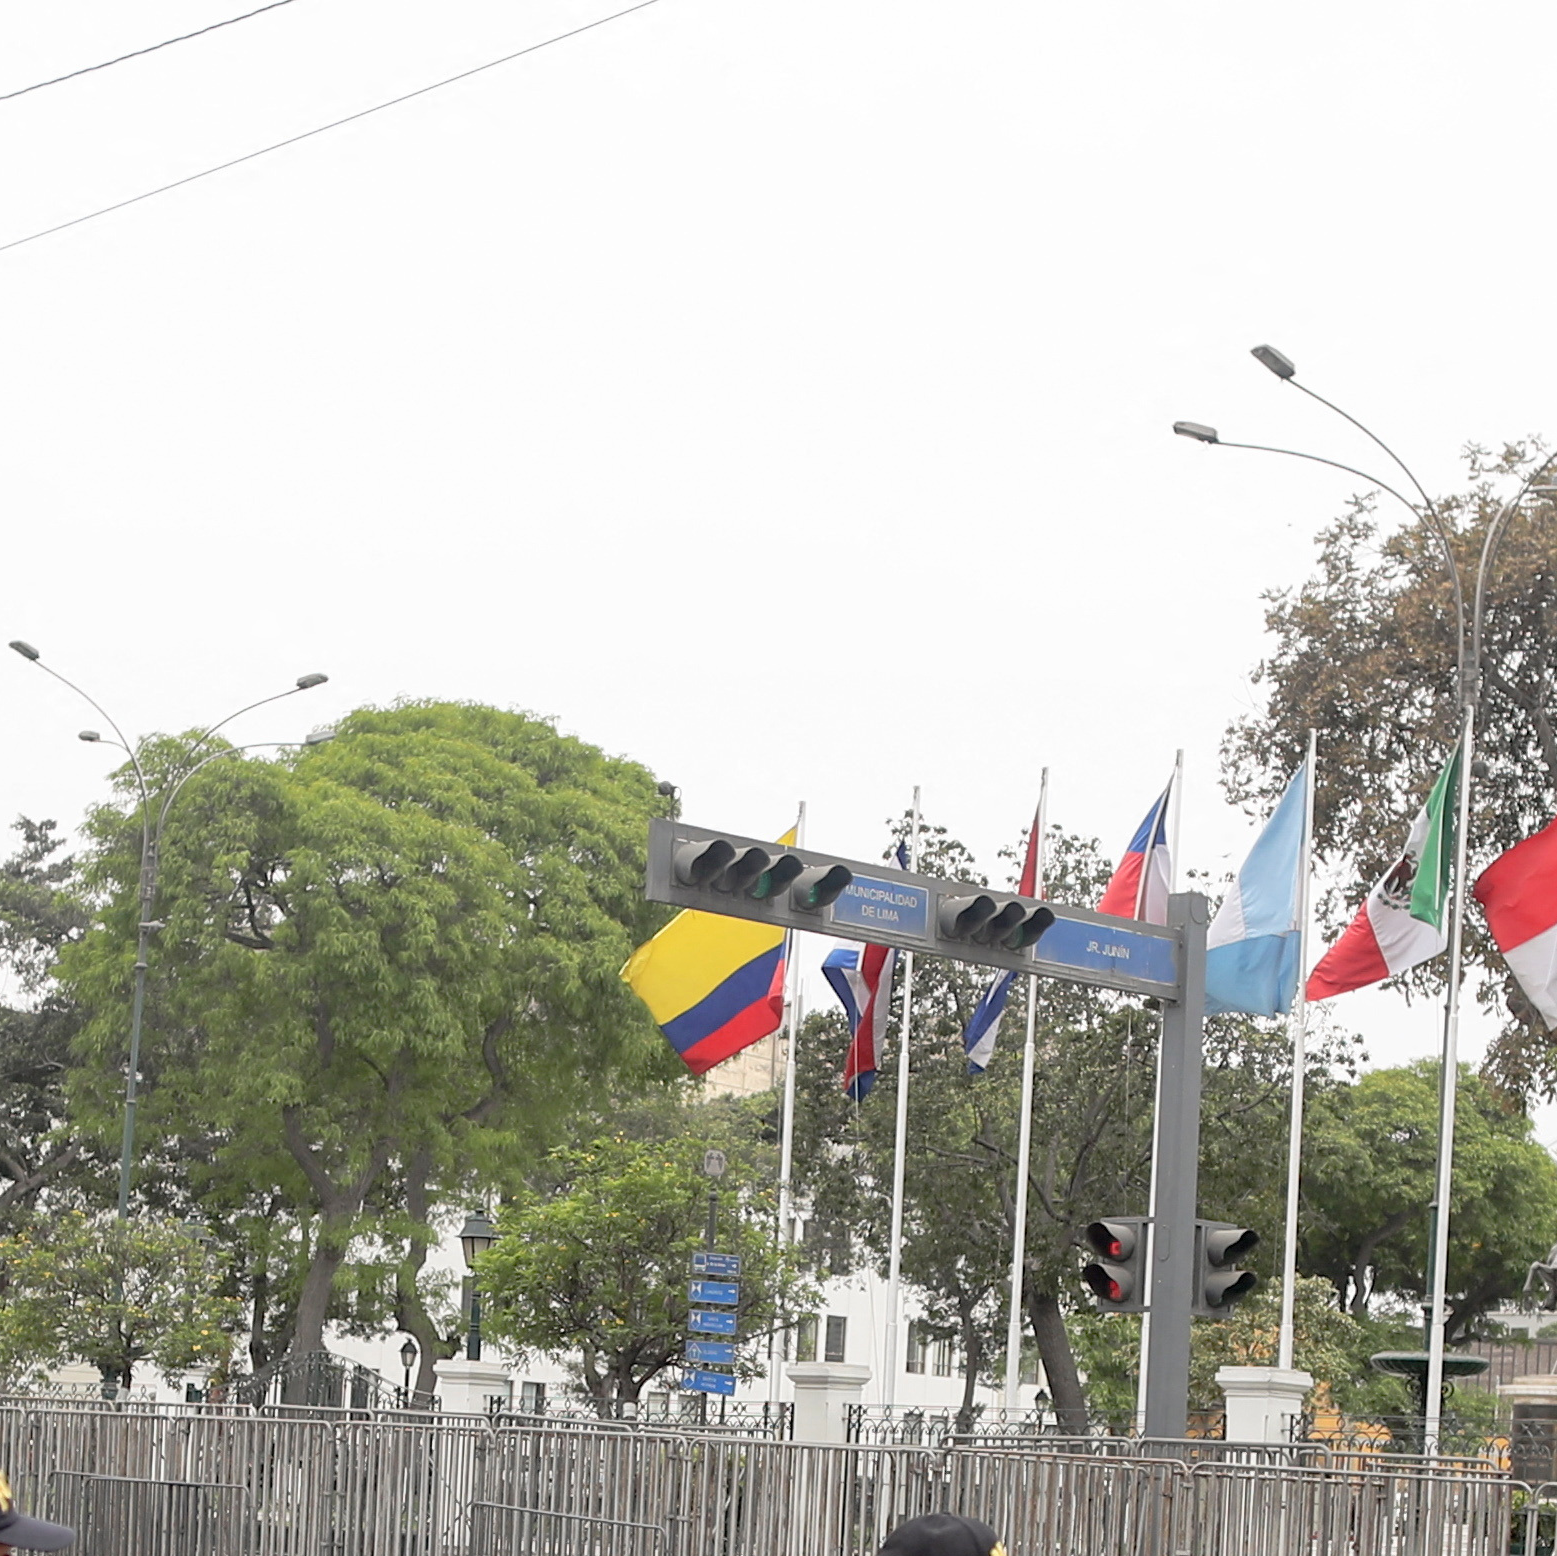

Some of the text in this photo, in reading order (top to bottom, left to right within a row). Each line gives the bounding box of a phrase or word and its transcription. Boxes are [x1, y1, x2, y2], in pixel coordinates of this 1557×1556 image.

[845, 885, 918, 908] MUNICIPALIDAD
[861, 905, 900, 922] DE LIMA
